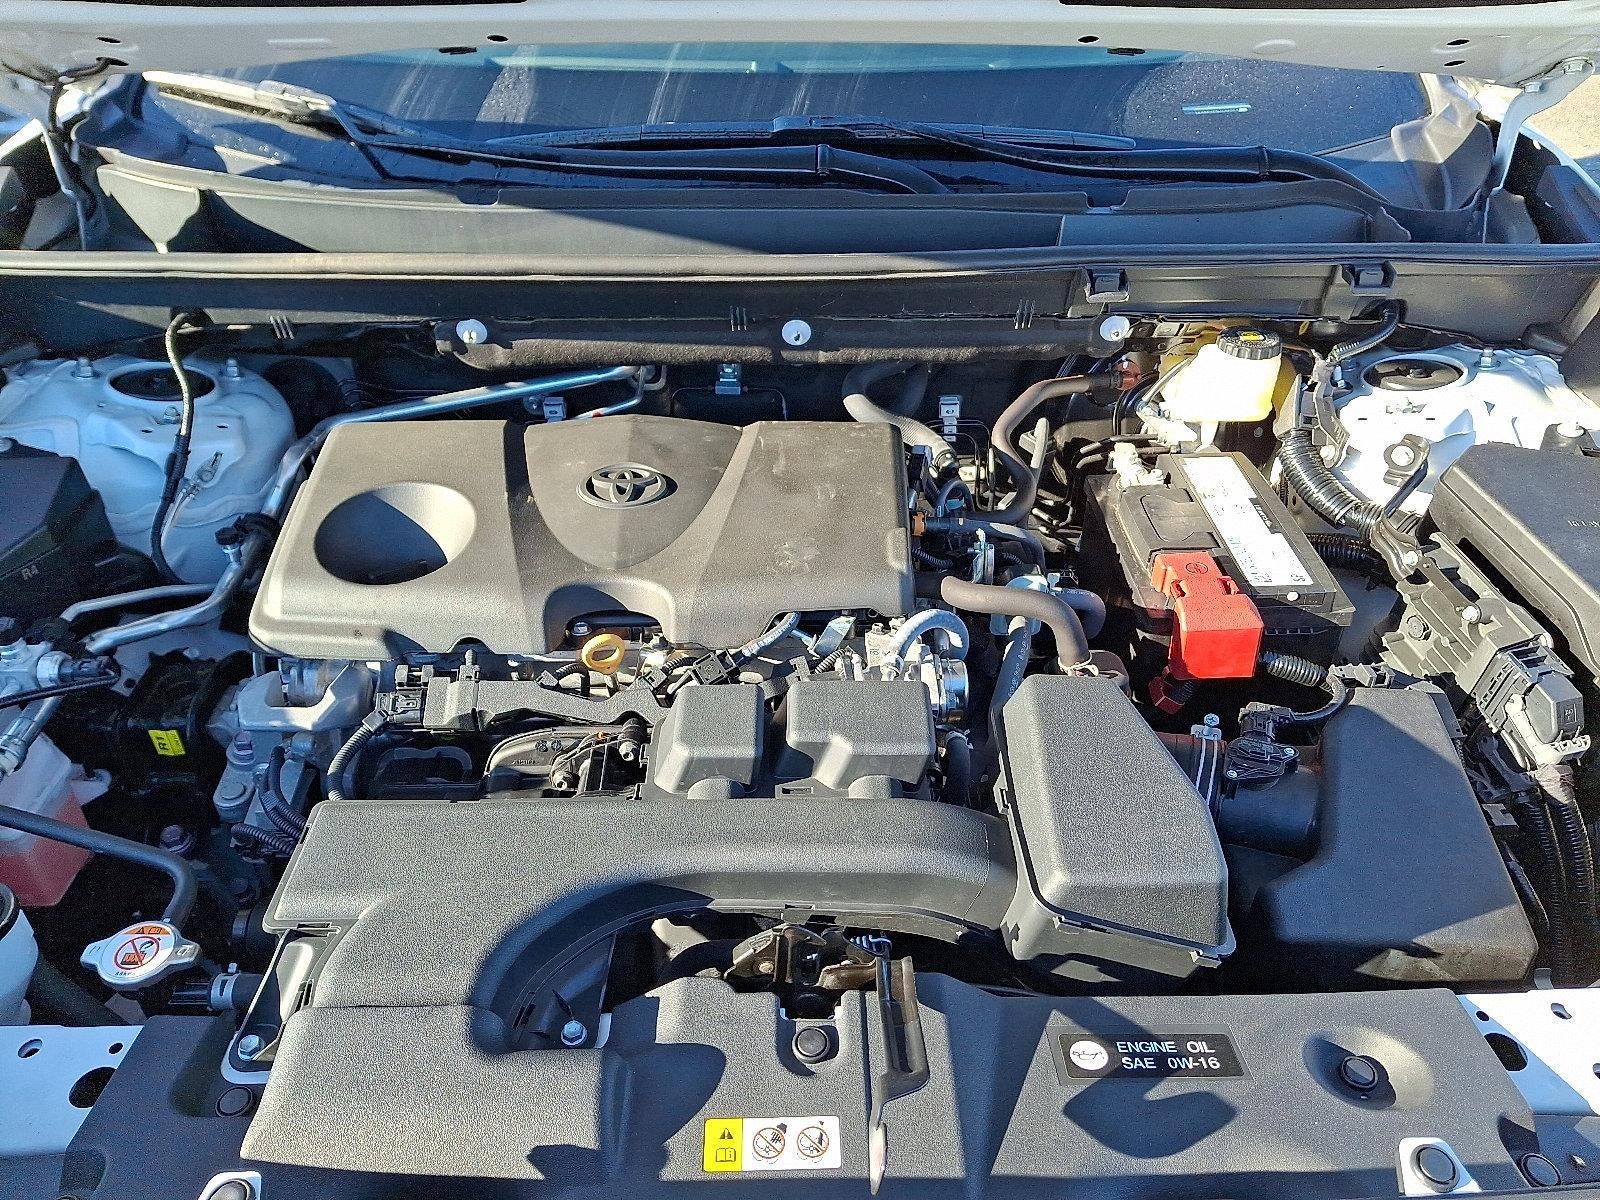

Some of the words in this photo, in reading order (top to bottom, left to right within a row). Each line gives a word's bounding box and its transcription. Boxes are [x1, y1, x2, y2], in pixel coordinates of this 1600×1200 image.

[1116, 1041, 1178, 1053] ENGINE
[1186, 1041, 1216, 1054] OIL
[1121, 1057, 1157, 1070] SAE
[1168, 1057, 1221, 1070] 0W-16
